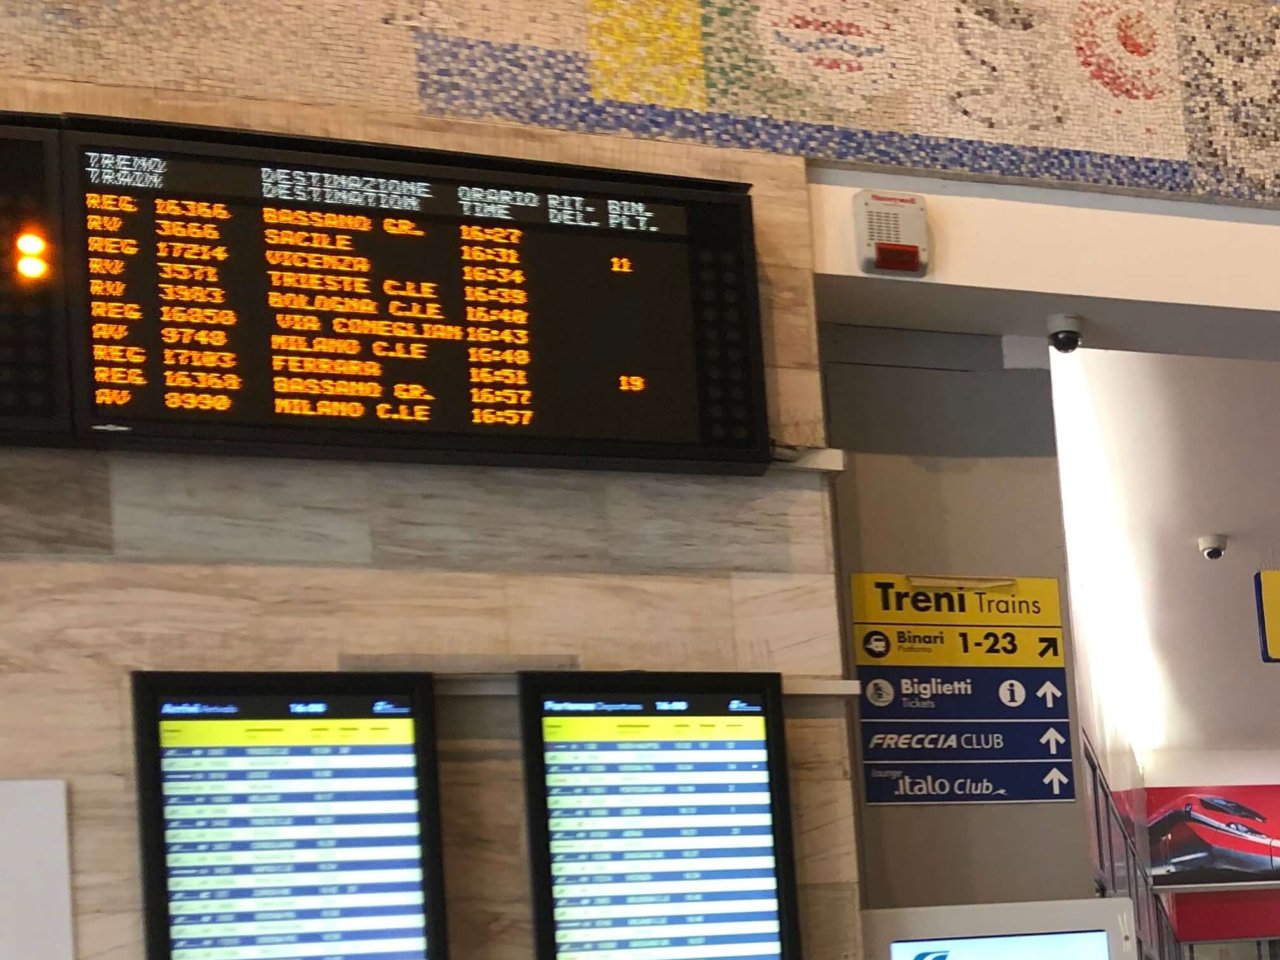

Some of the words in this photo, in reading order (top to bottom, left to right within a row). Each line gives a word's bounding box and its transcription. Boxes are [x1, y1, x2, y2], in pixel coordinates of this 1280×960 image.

[85, 152, 167, 172] TRENO
[261, 167, 434, 198] DESTINAZIONE
[457, 186, 541, 208] ORARIO
[547, 194, 596, 213] RIT.
[261, 183, 421, 212] DESTINATION
[458, 200, 515, 220] TIME
[86, 193, 138, 212] REG
[262, 207, 373, 232] BASSANO
[459, 225, 524, 244] 16:27
[88, 237, 139, 254] REG
[265, 250, 372, 272] VICENZA
[462, 265, 526, 284] 16:34
[264, 228, 355, 250] SACILE
[461, 245, 521, 264] 16:31
[610, 257, 634, 273] 11
[266, 271, 372, 294] TRIESTE
[268, 291, 379, 315] BOLOGNA
[91, 302, 143, 319] REG
[275, 314, 322, 331] VIA
[467, 327, 529, 344] 16:43
[271, 334, 361, 355] MILANO
[93, 344, 147, 363] REG
[272, 355, 383, 377] FERRARA
[619, 376, 647, 391] 19
[94, 366, 147, 385] REG
[273, 376, 384, 398] BASSANO
[470, 388, 532, 405] 16:57
[274, 398, 366, 418] MILANO
[471, 408, 534, 425] 16:57
[875, 582, 966, 613] Treni
[975, 591, 1041, 614] Trains
[896, 631, 944, 645] Binari
[959, 632, 1018, 654] 1-23
[900, 678, 972, 698] Biglietti
[868, 734, 957, 748] FRECCIA
[961, 734, 1004, 749] CLUB
[953, 778, 993, 795] Club
